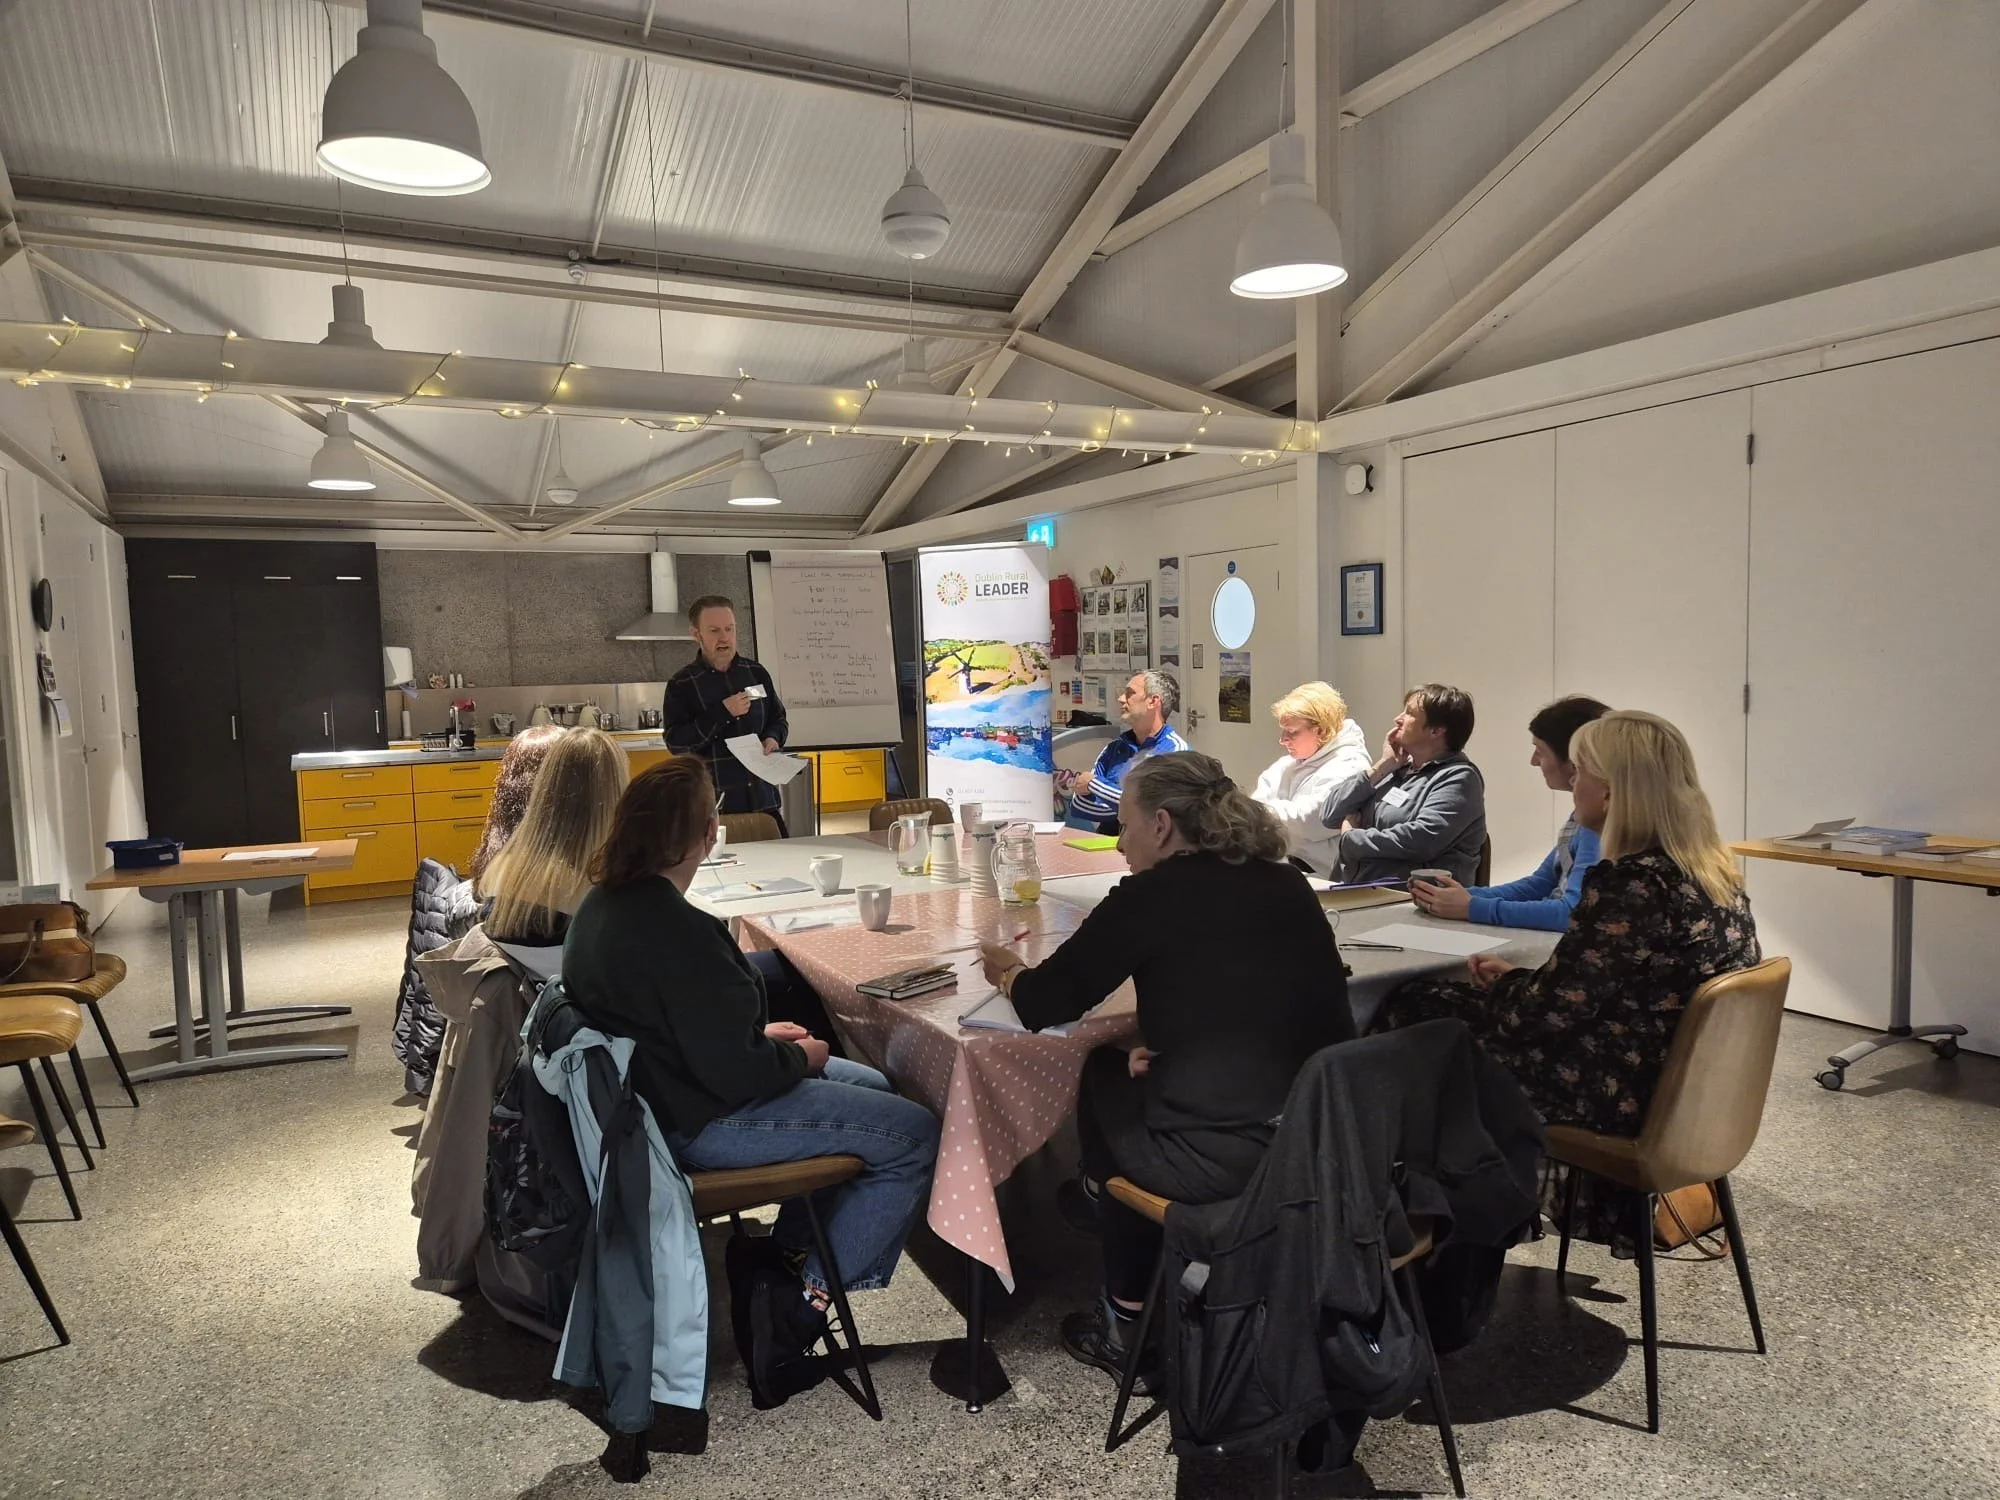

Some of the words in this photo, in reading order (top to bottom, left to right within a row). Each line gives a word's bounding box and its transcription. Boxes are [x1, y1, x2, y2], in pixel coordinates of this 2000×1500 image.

[975, 572, 1002, 583] Dublin
[1004, 570, 1029, 581] Rural
[975, 582, 1029, 597] LEADER
